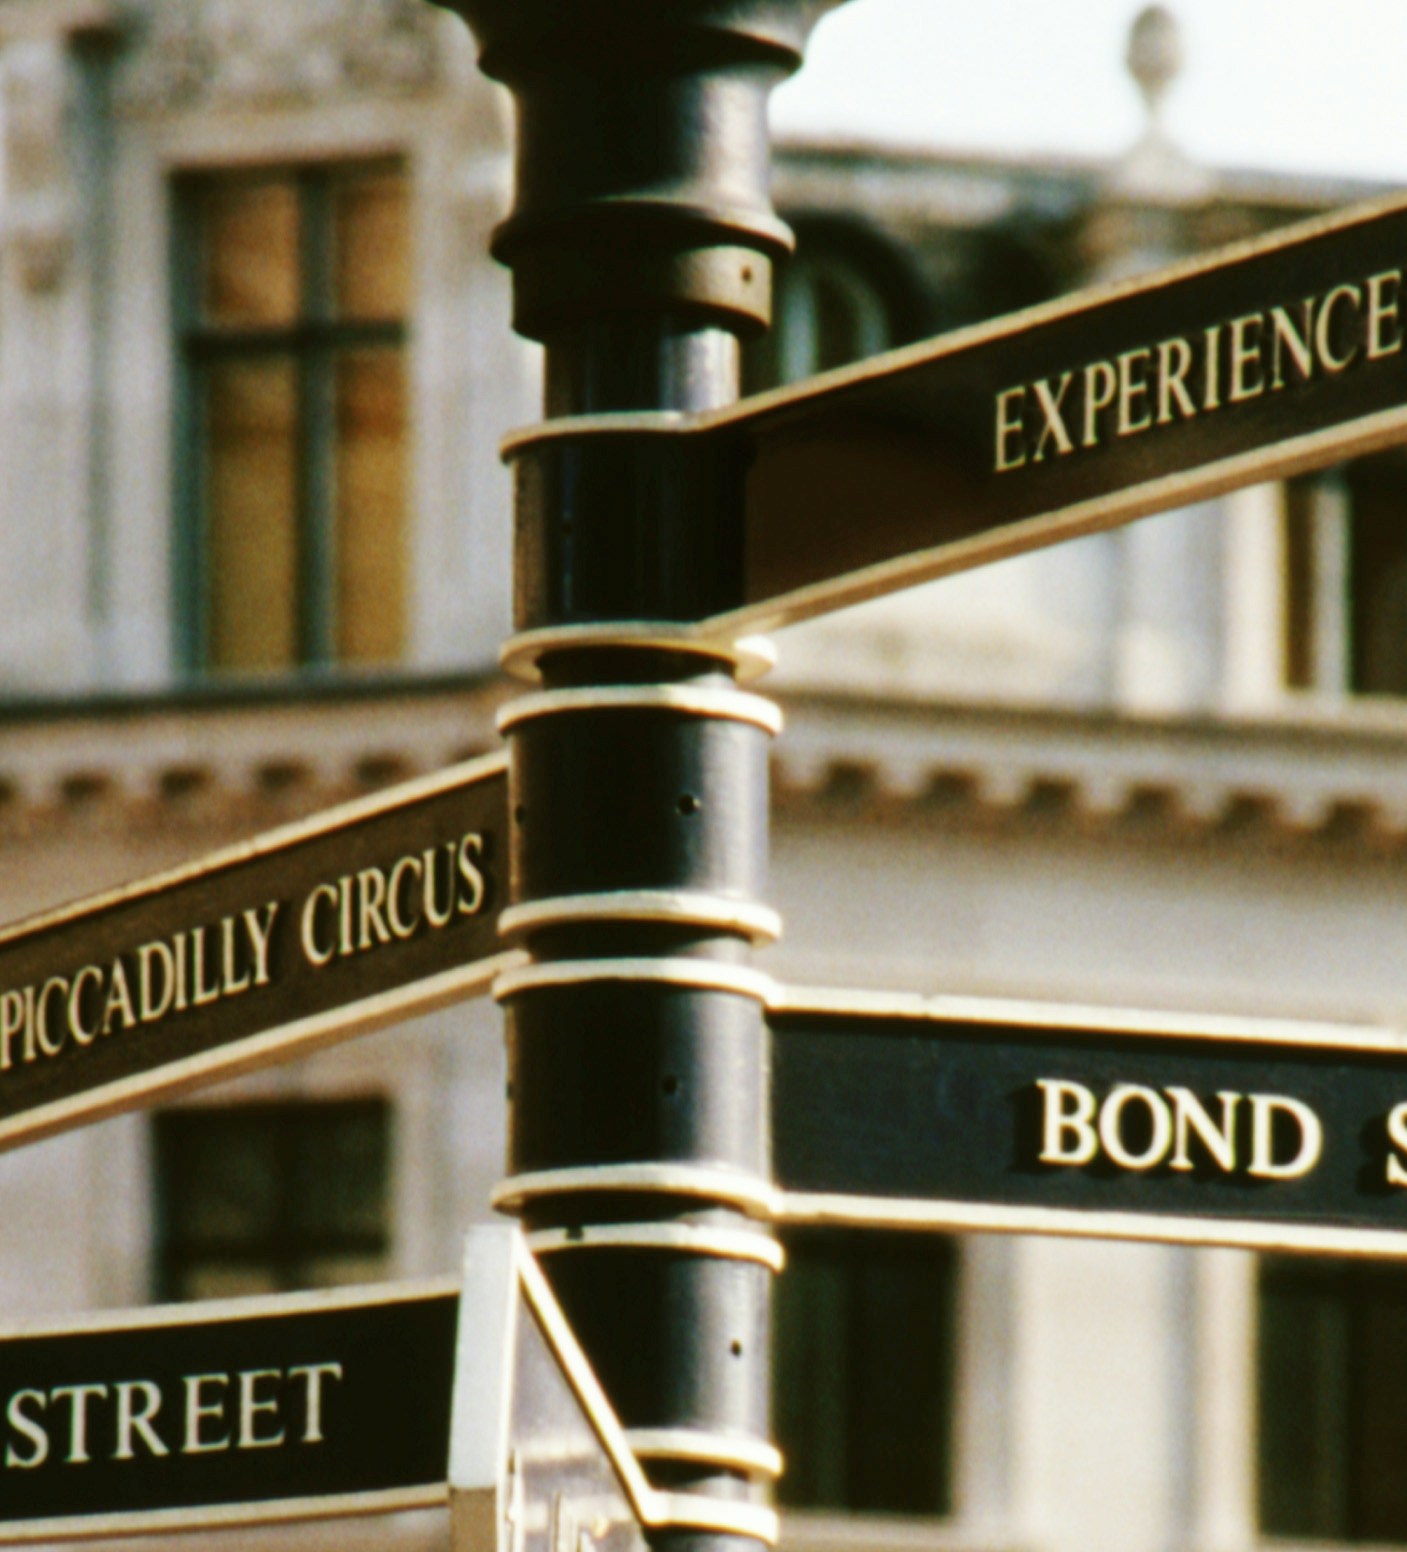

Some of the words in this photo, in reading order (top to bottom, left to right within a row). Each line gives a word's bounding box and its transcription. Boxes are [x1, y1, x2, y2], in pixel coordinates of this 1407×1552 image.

[994, 269, 1403, 472] EXPERIENCE
[299, 832, 485, 966] CIRCUS
[1034, 1078, 1323, 1179] BOND
[3, 1360, 345, 1468] STREET
